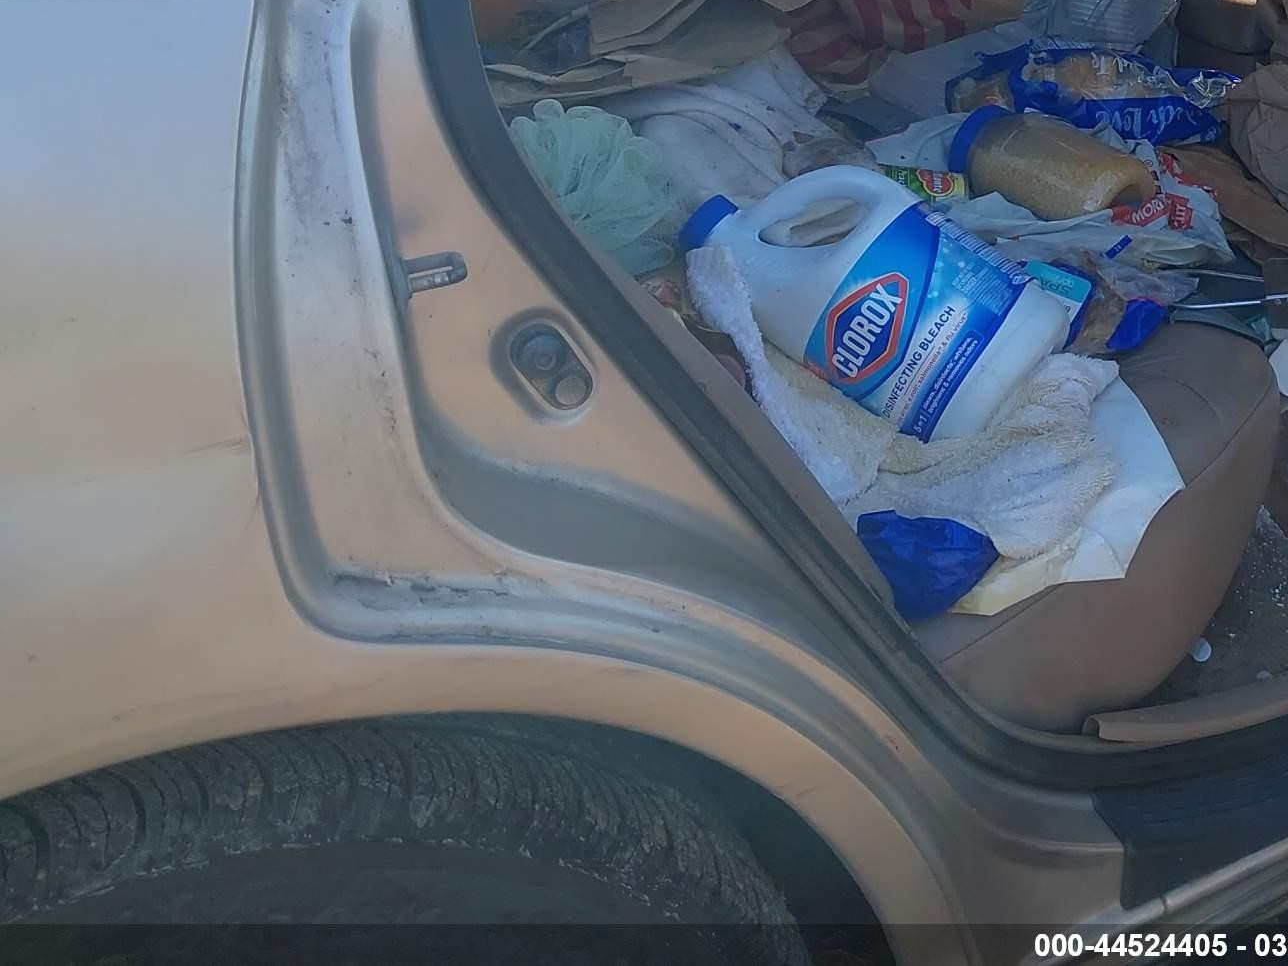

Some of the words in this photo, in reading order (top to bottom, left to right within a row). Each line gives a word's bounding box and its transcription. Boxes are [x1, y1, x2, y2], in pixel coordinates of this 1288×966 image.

[831, 283, 904, 379] CLOROX
[882, 351, 923, 418] DISINFECTING
[919, 305, 956, 352] BLEACH
[948, 356, 967, 383] removes
[964, 339, 979, 358] odors
